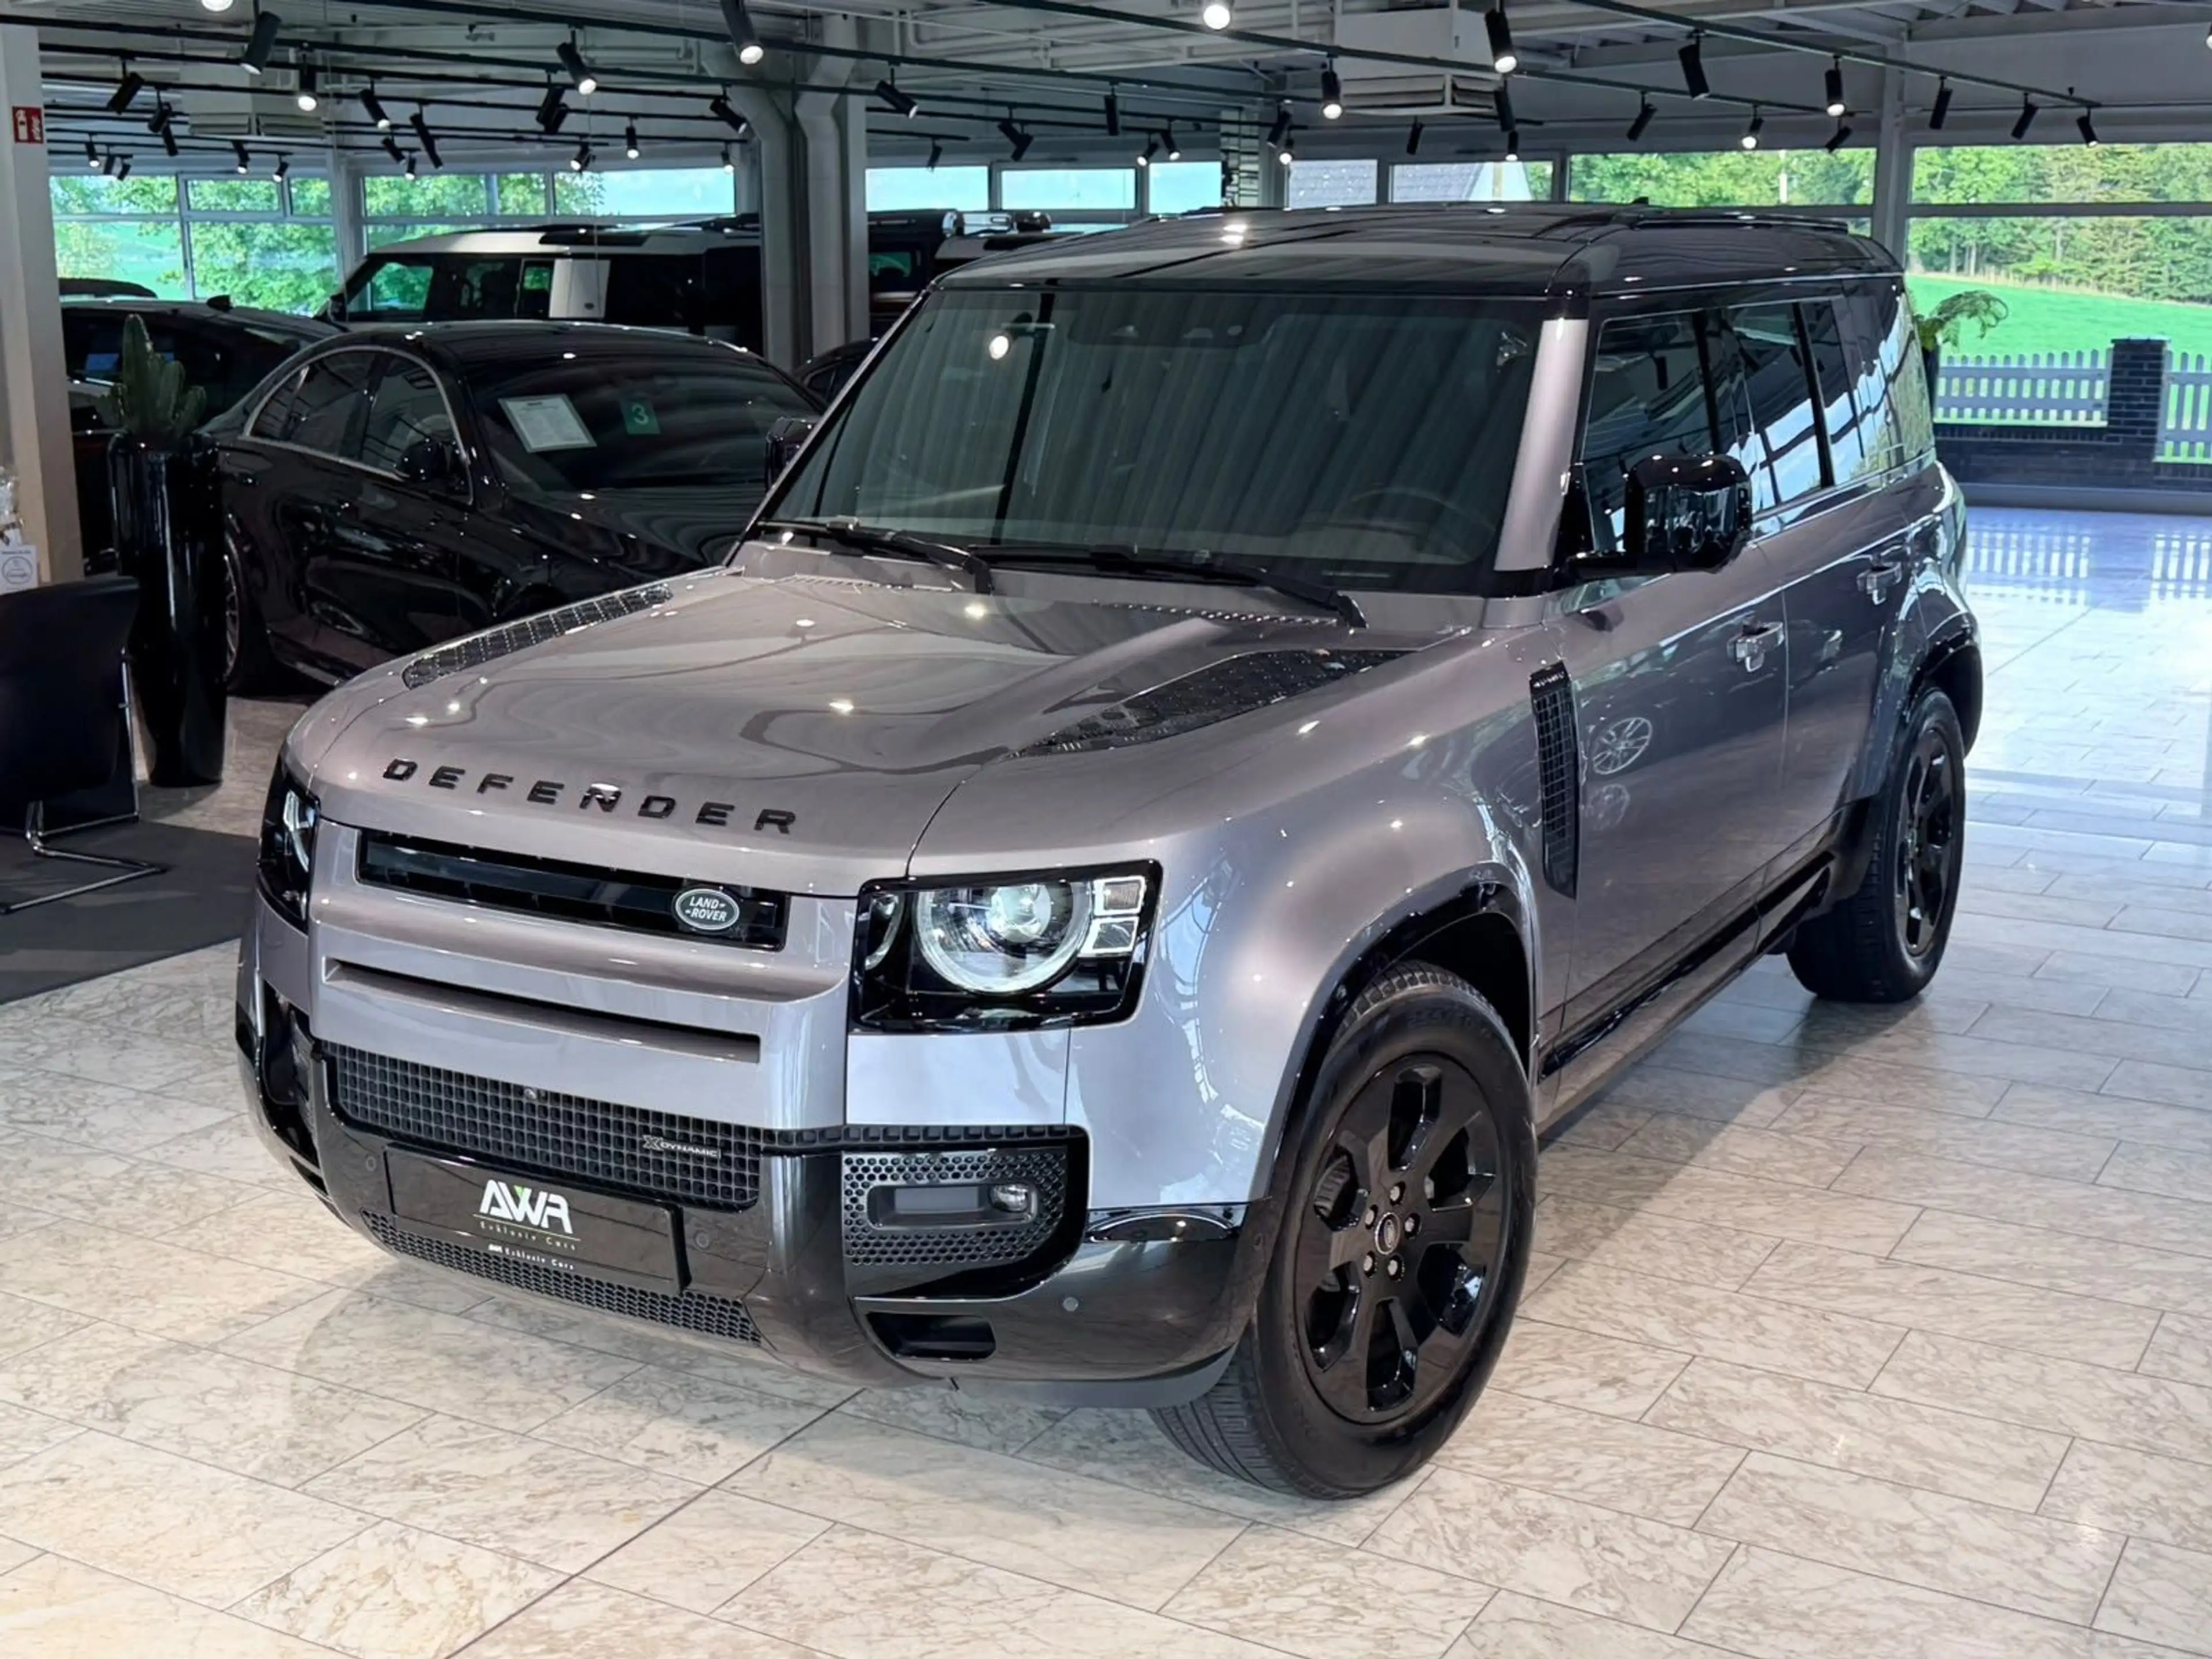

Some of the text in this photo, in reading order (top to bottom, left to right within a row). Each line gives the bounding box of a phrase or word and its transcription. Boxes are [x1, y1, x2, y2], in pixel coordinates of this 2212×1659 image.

[631, 403, 649, 425] 3
[382, 758, 797, 834] DEFENDER
[479, 1179, 574, 1234] AWR
